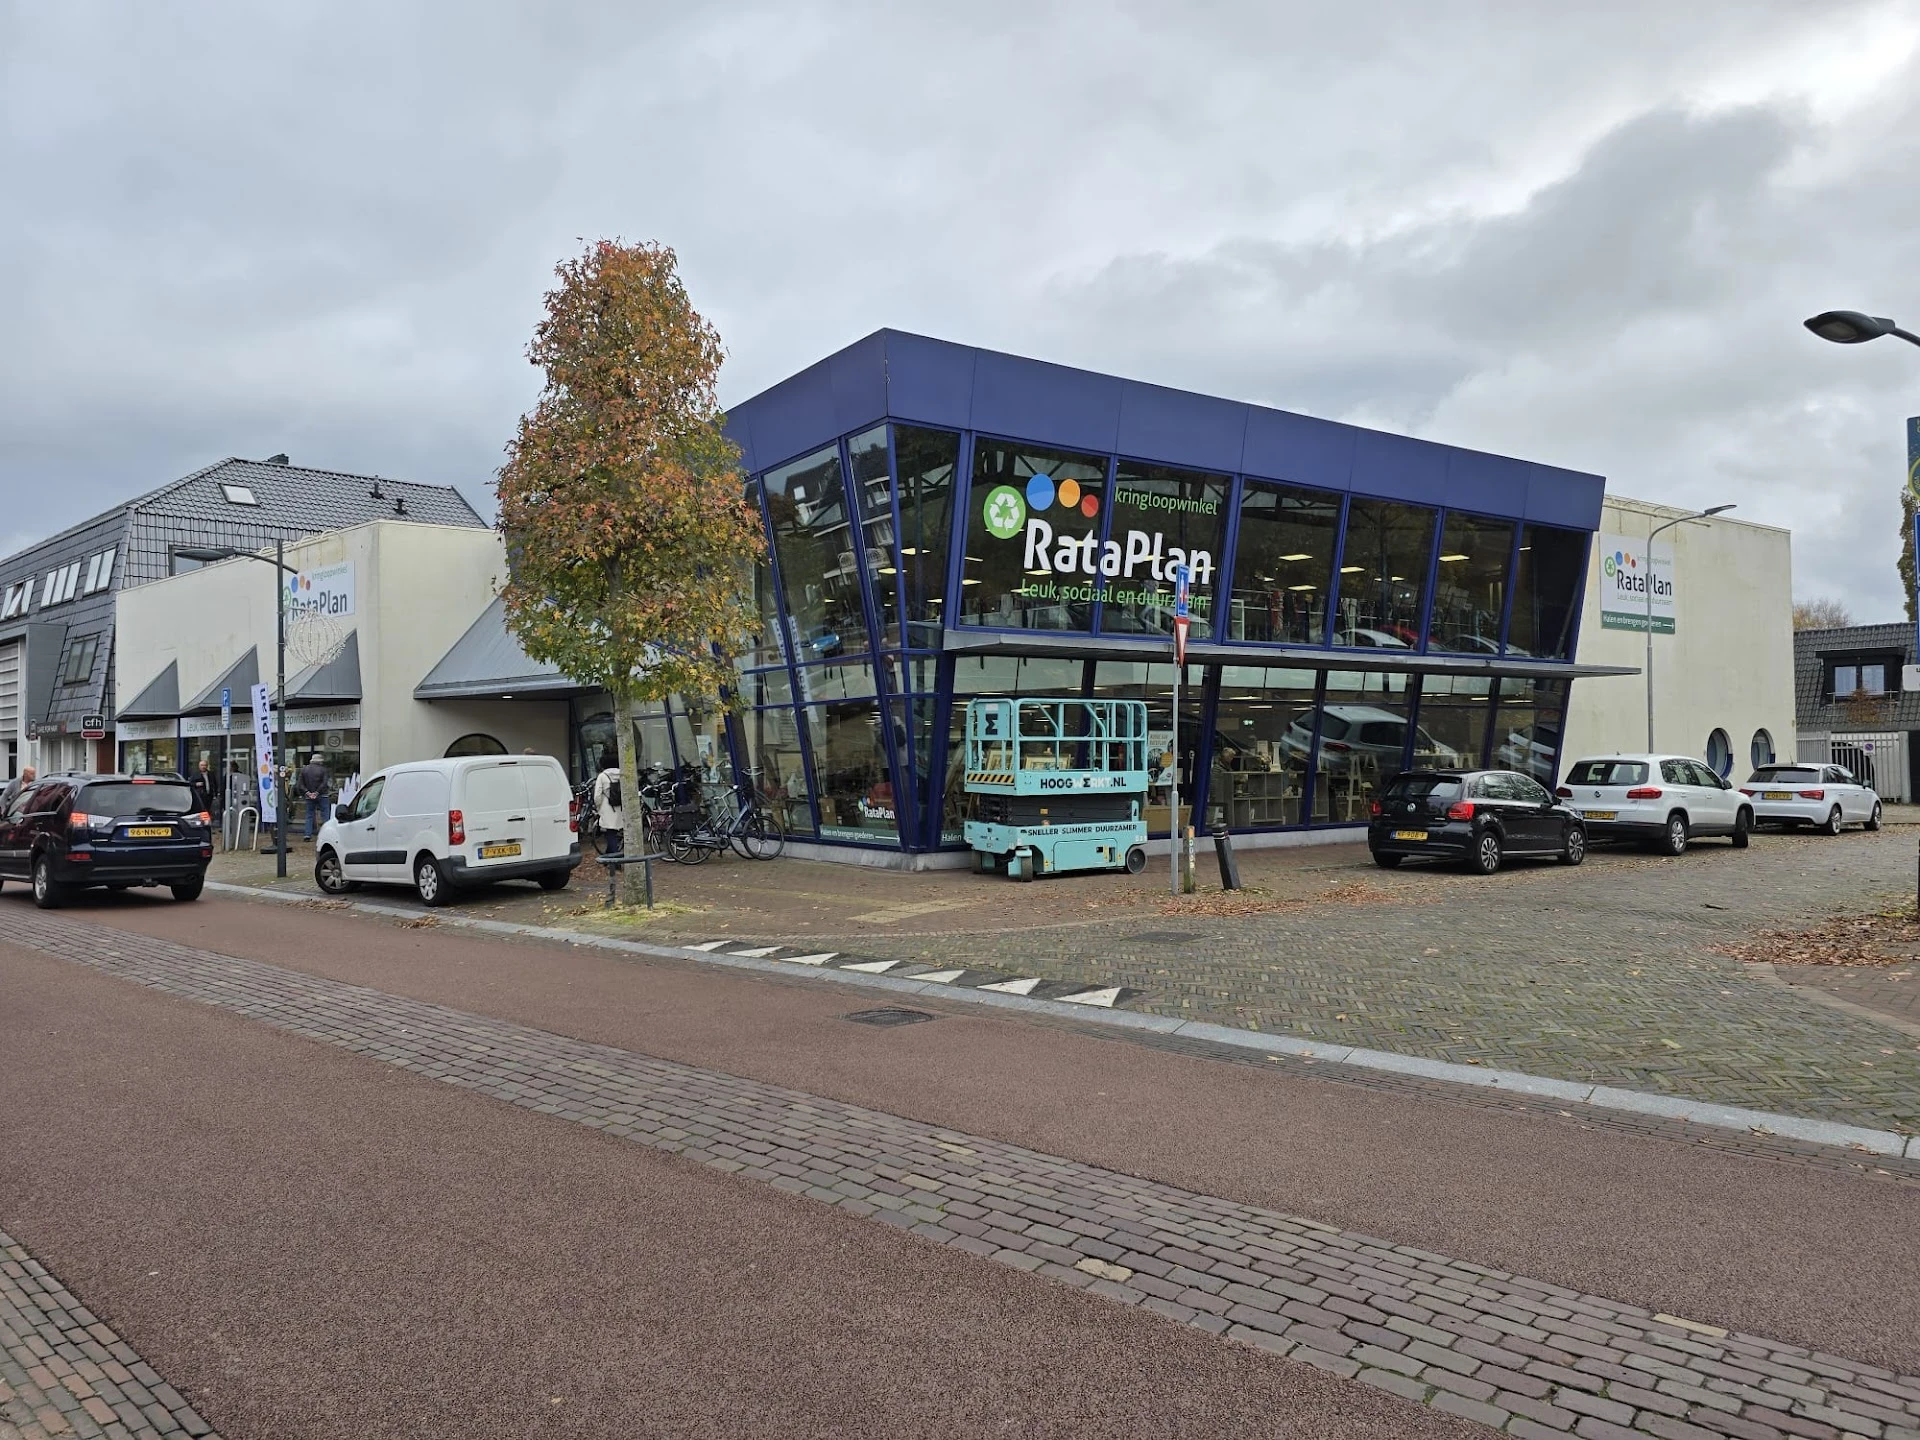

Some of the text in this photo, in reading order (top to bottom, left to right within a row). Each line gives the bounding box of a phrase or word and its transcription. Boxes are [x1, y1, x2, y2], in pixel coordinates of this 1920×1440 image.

[1114, 486, 1218, 516] kringloopwinkel
[1023, 518, 1212, 585] RataPlan
[1021, 578, 1207, 610] Leuk, sociaal en duurzam
[84, 717, 102, 727] cfh
[864, 806, 896, 820] RataPlan
[130, 828, 170, 836] 96-NNG-9
[941, 833, 962, 841] Halen
[1027, 824, 1137, 837] SNELLER SLIMMER DUURZAMER
